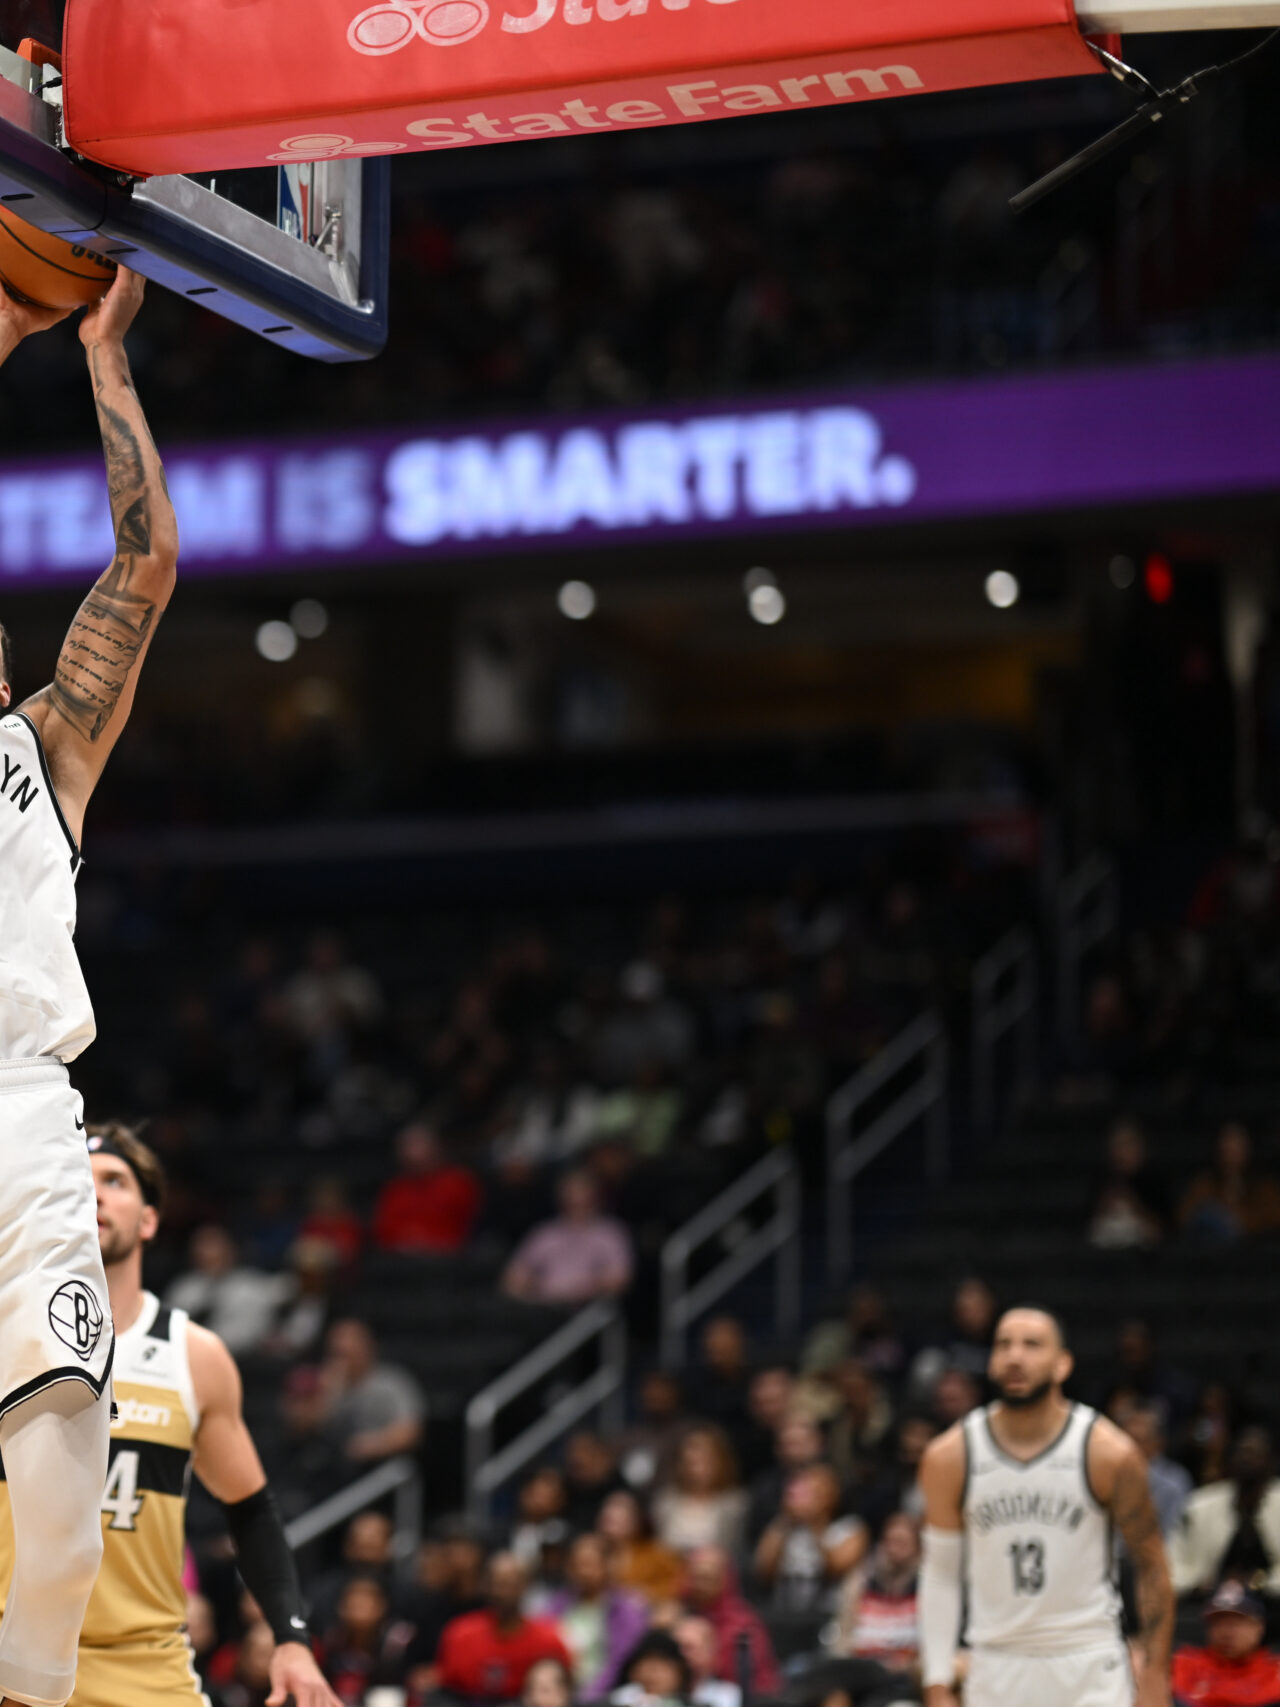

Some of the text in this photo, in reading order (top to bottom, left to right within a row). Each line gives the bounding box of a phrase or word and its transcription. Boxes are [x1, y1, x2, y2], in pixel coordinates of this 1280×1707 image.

[406, 63, 925, 146] State Farm
[273, 448, 375, 554] IS
[383, 403, 916, 547] SMARTER.
[73, 1291, 91, 1348] B
[1006, 1540, 1045, 1596] 13
